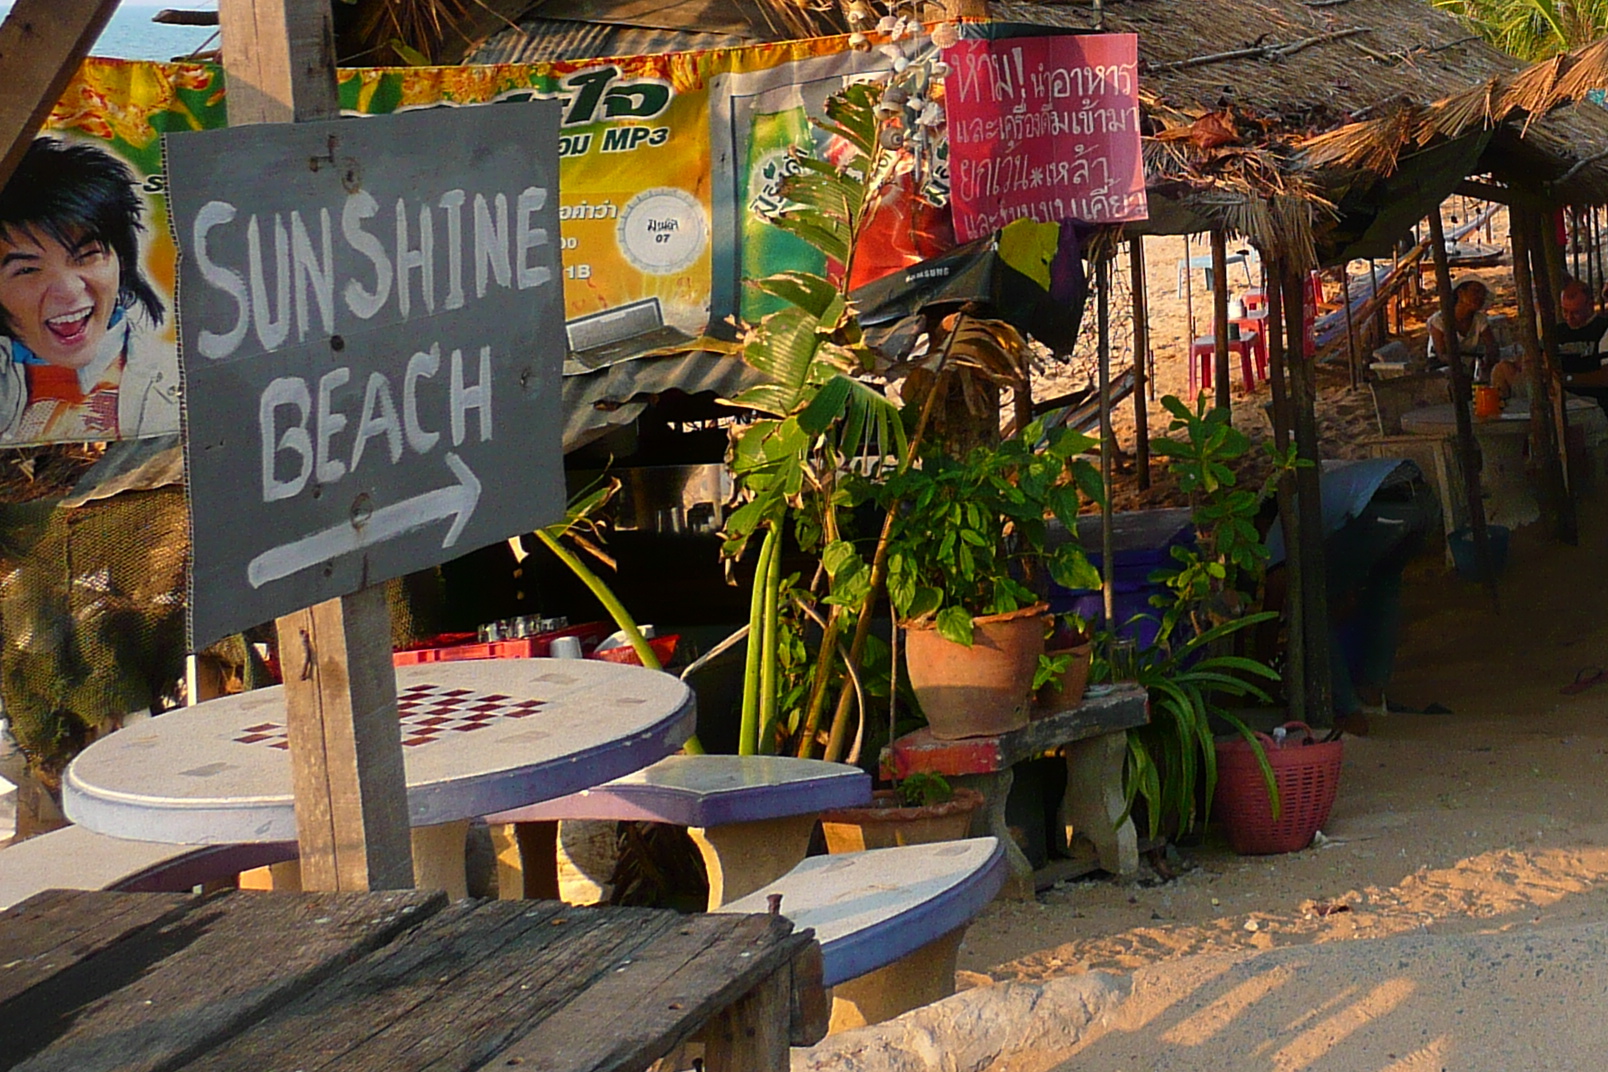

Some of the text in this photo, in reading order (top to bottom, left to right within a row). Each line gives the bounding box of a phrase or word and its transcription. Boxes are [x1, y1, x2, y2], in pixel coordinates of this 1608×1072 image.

[951, 40, 1027, 103] ห้าม!
[602, 127, 669, 151] MP3
[655, 234, 671, 243] 07
[193, 186, 552, 360] SUNSHINE
[259, 341, 493, 503] BEACH
